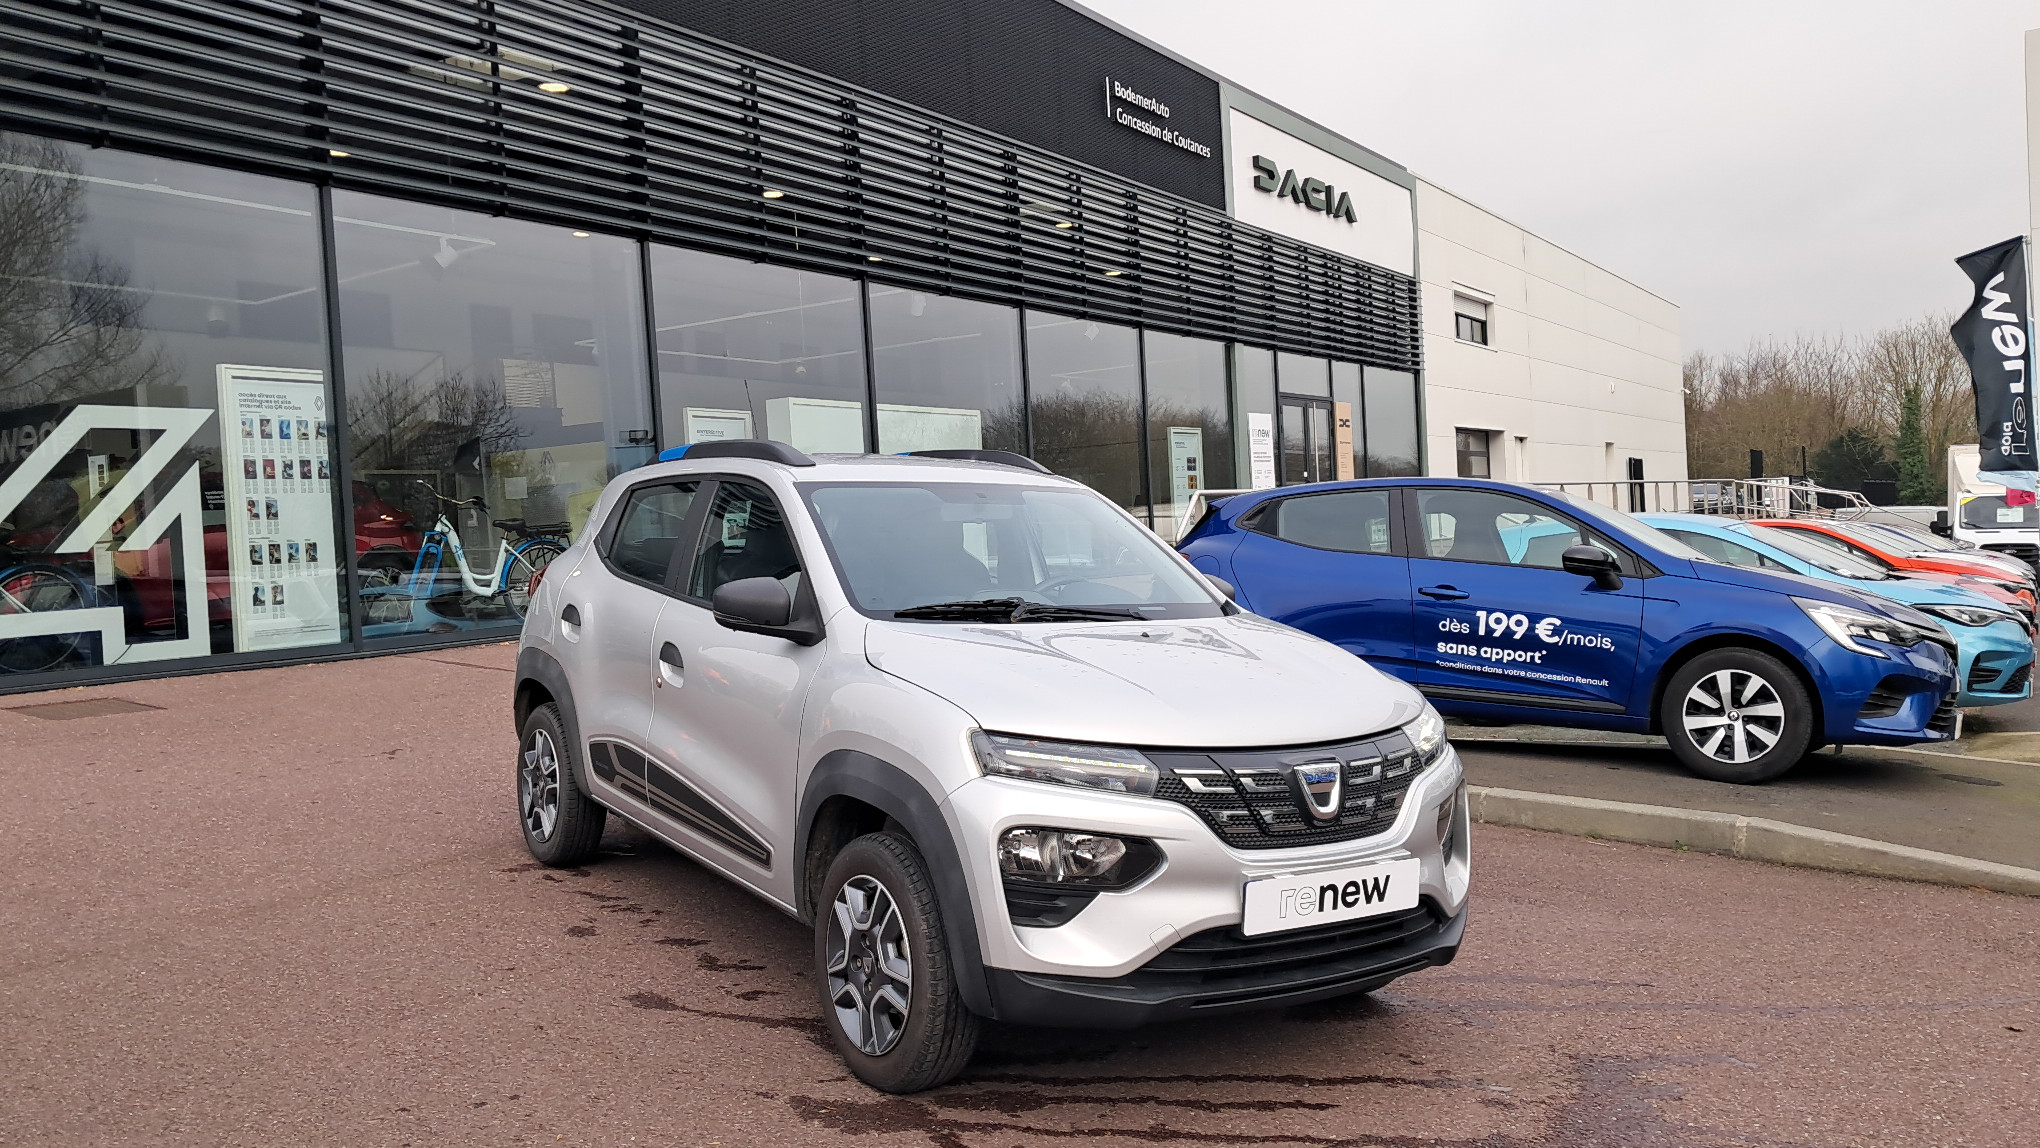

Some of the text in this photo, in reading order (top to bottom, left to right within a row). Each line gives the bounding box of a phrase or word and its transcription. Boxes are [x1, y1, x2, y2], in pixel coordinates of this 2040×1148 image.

[1114, 80, 1170, 119] BodemerAuto
[1116, 107, 1211, 158] Concession de Coutances
[1252, 154, 1358, 224] DACIA
[1438, 617, 1470, 634] dès
[1476, 610, 1529, 640] 199
[1437, 641, 1478, 657] sans
[1482, 665, 1503, 675] dans
[1503, 668, 1526, 678] votre
[1526, 670, 1575, 684] concession
[1575, 676, 1609, 687] Renault
[1304, 771, 1337, 784] DACIA
[1279, 874, 1391, 919] renew
